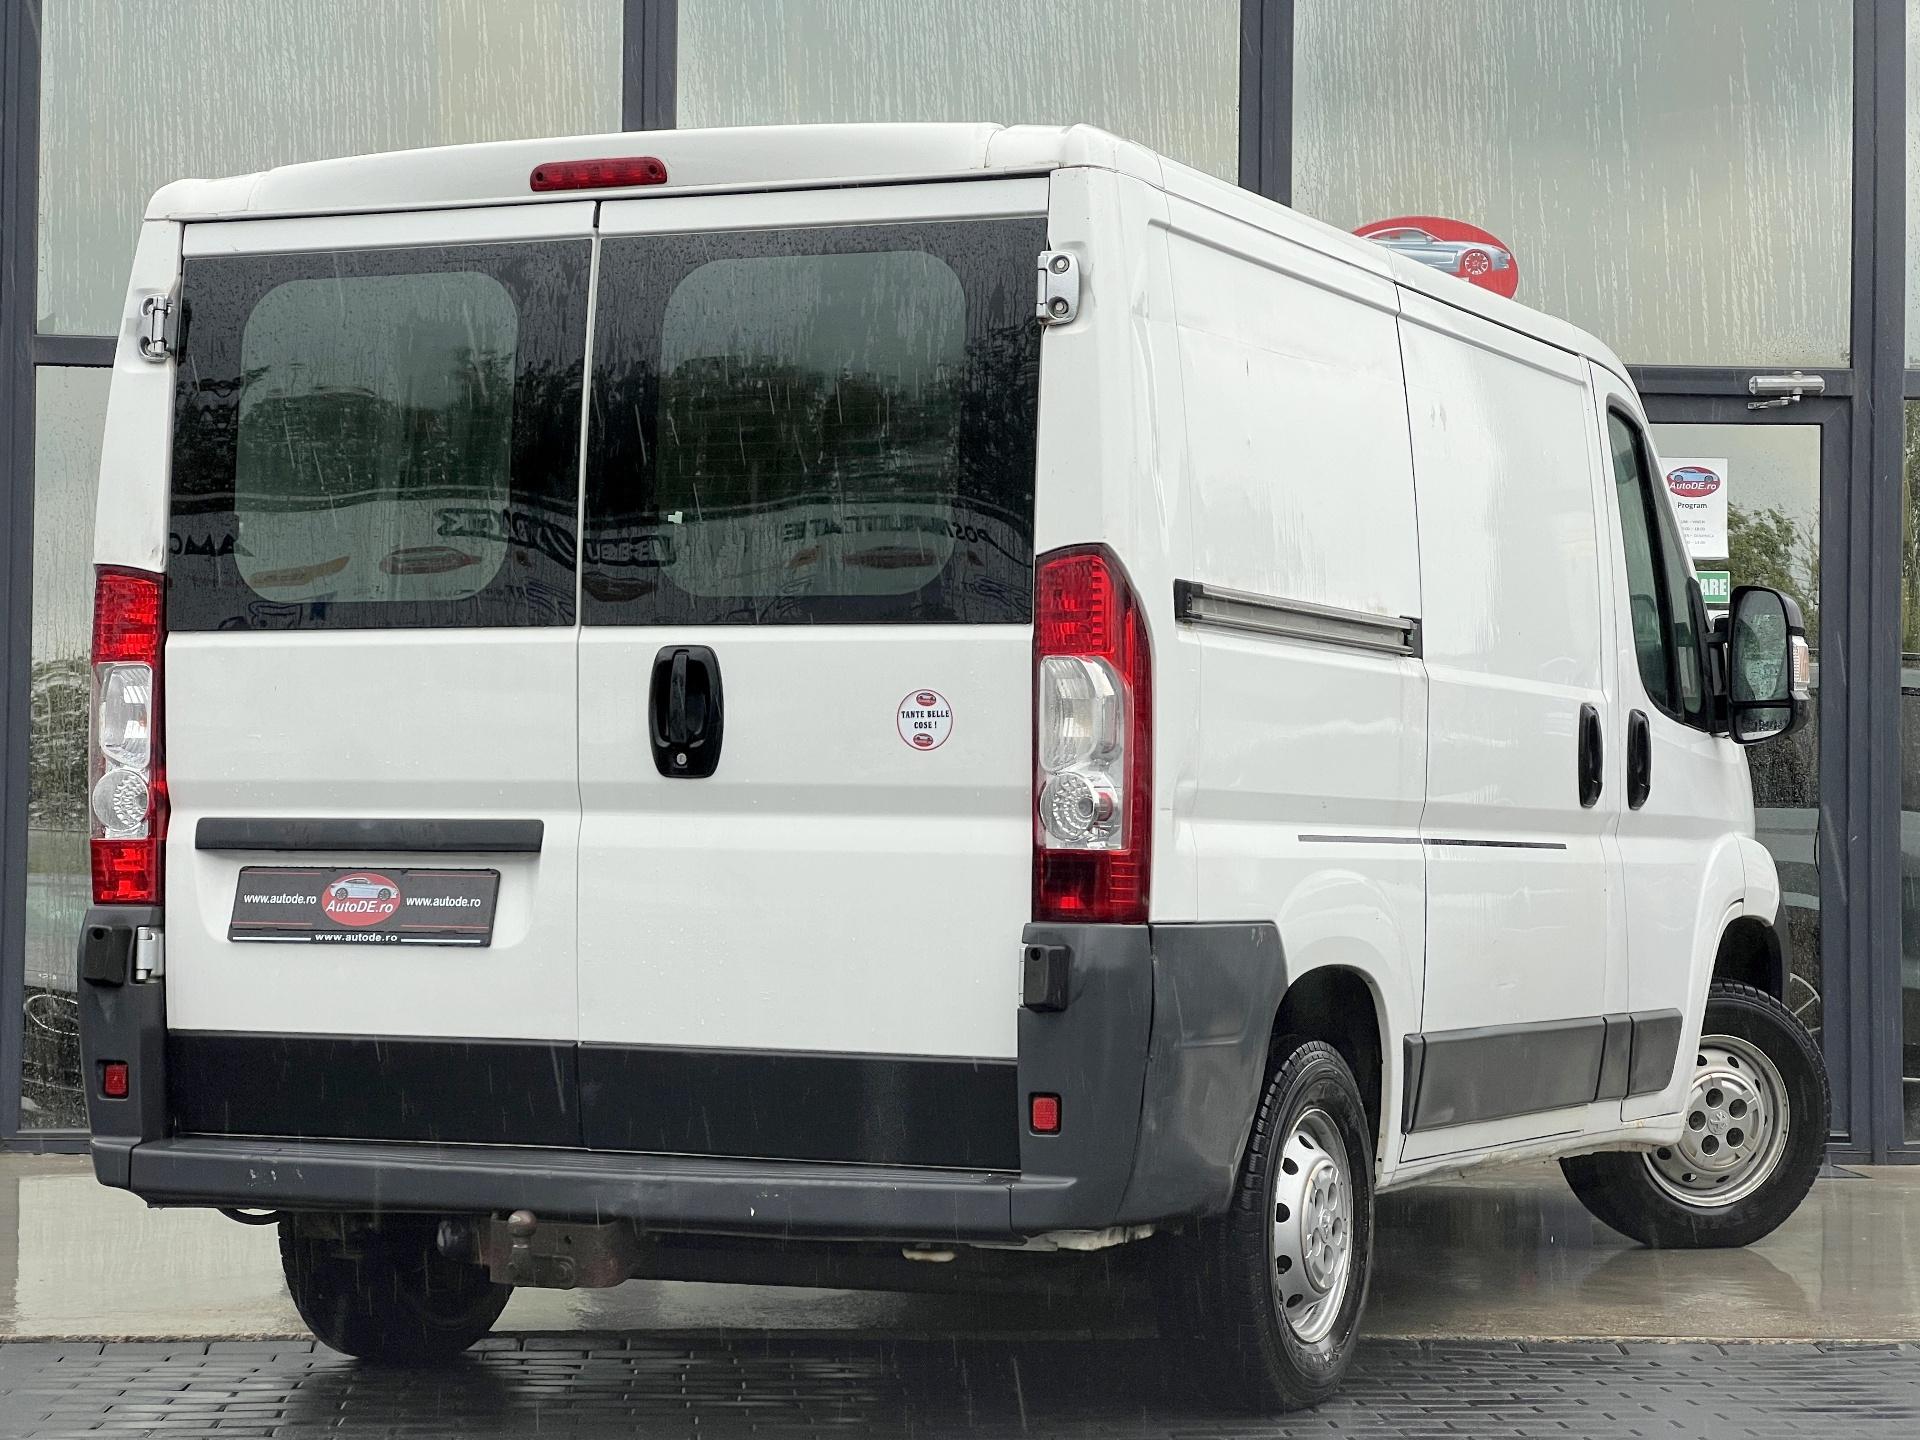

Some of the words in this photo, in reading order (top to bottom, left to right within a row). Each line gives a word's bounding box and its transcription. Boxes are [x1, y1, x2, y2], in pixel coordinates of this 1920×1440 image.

[1668, 481, 1717, 491] AutoDE.ro
[1677, 502, 1707, 510] Program
[901, 711, 925, 719] TANTE
[927, 710, 949, 718] BELLE
[243, 893, 316, 905] www.autode.ro
[406, 896, 480, 908] www.autode.ro
[326, 901, 392, 914] AutoDE.ro
[314, 932, 397, 943] www.autode.ro
